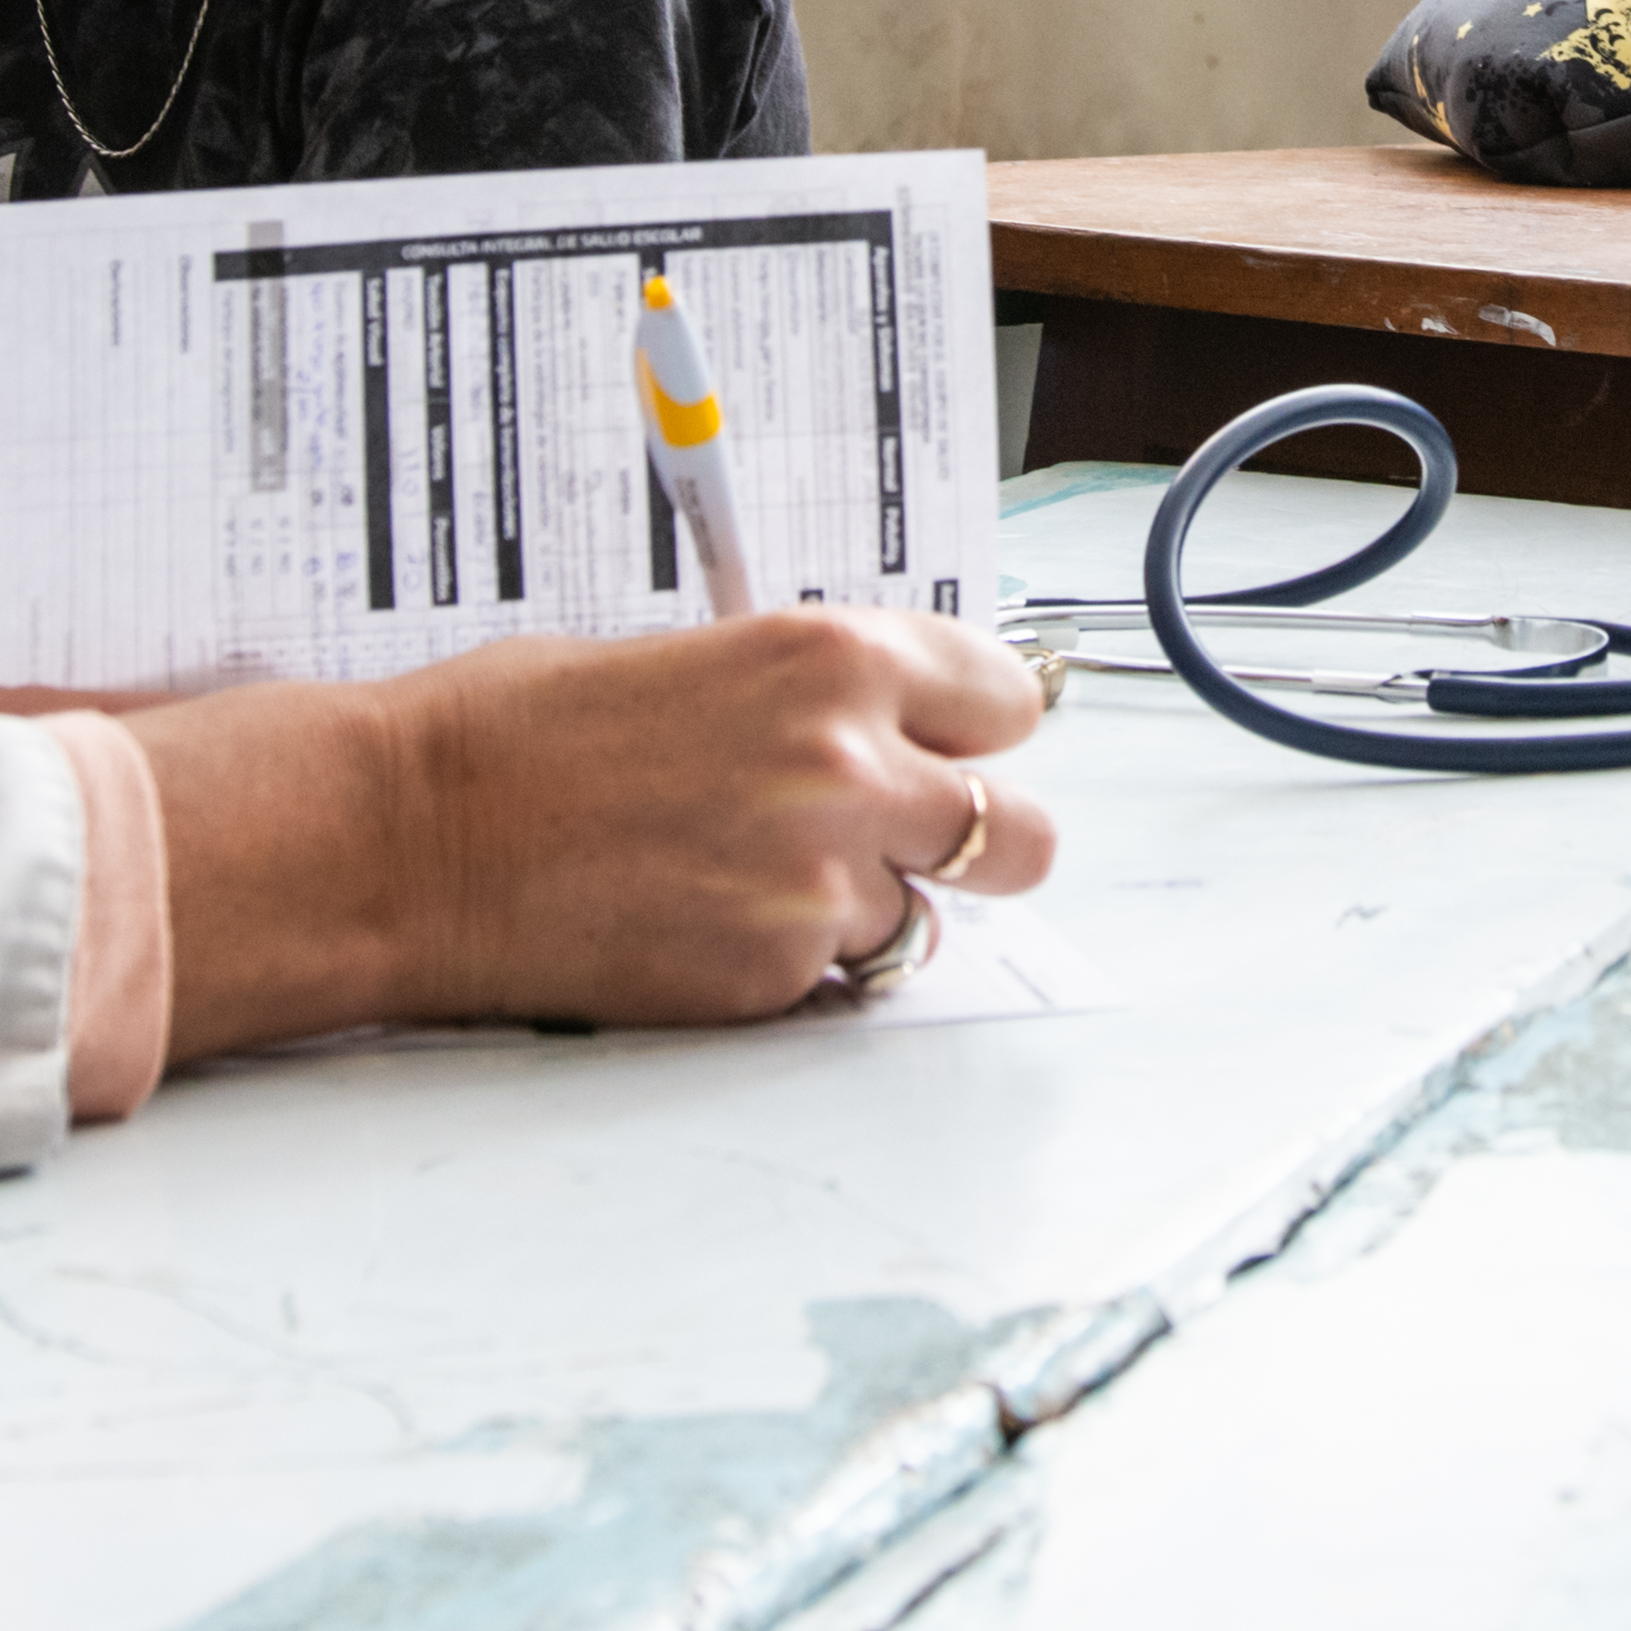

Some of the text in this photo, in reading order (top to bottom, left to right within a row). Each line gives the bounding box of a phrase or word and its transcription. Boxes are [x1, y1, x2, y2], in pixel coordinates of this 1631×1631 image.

[402, 225, 702, 260] CONSULTA INTEGRAL DE SALUD ESCOLAR
